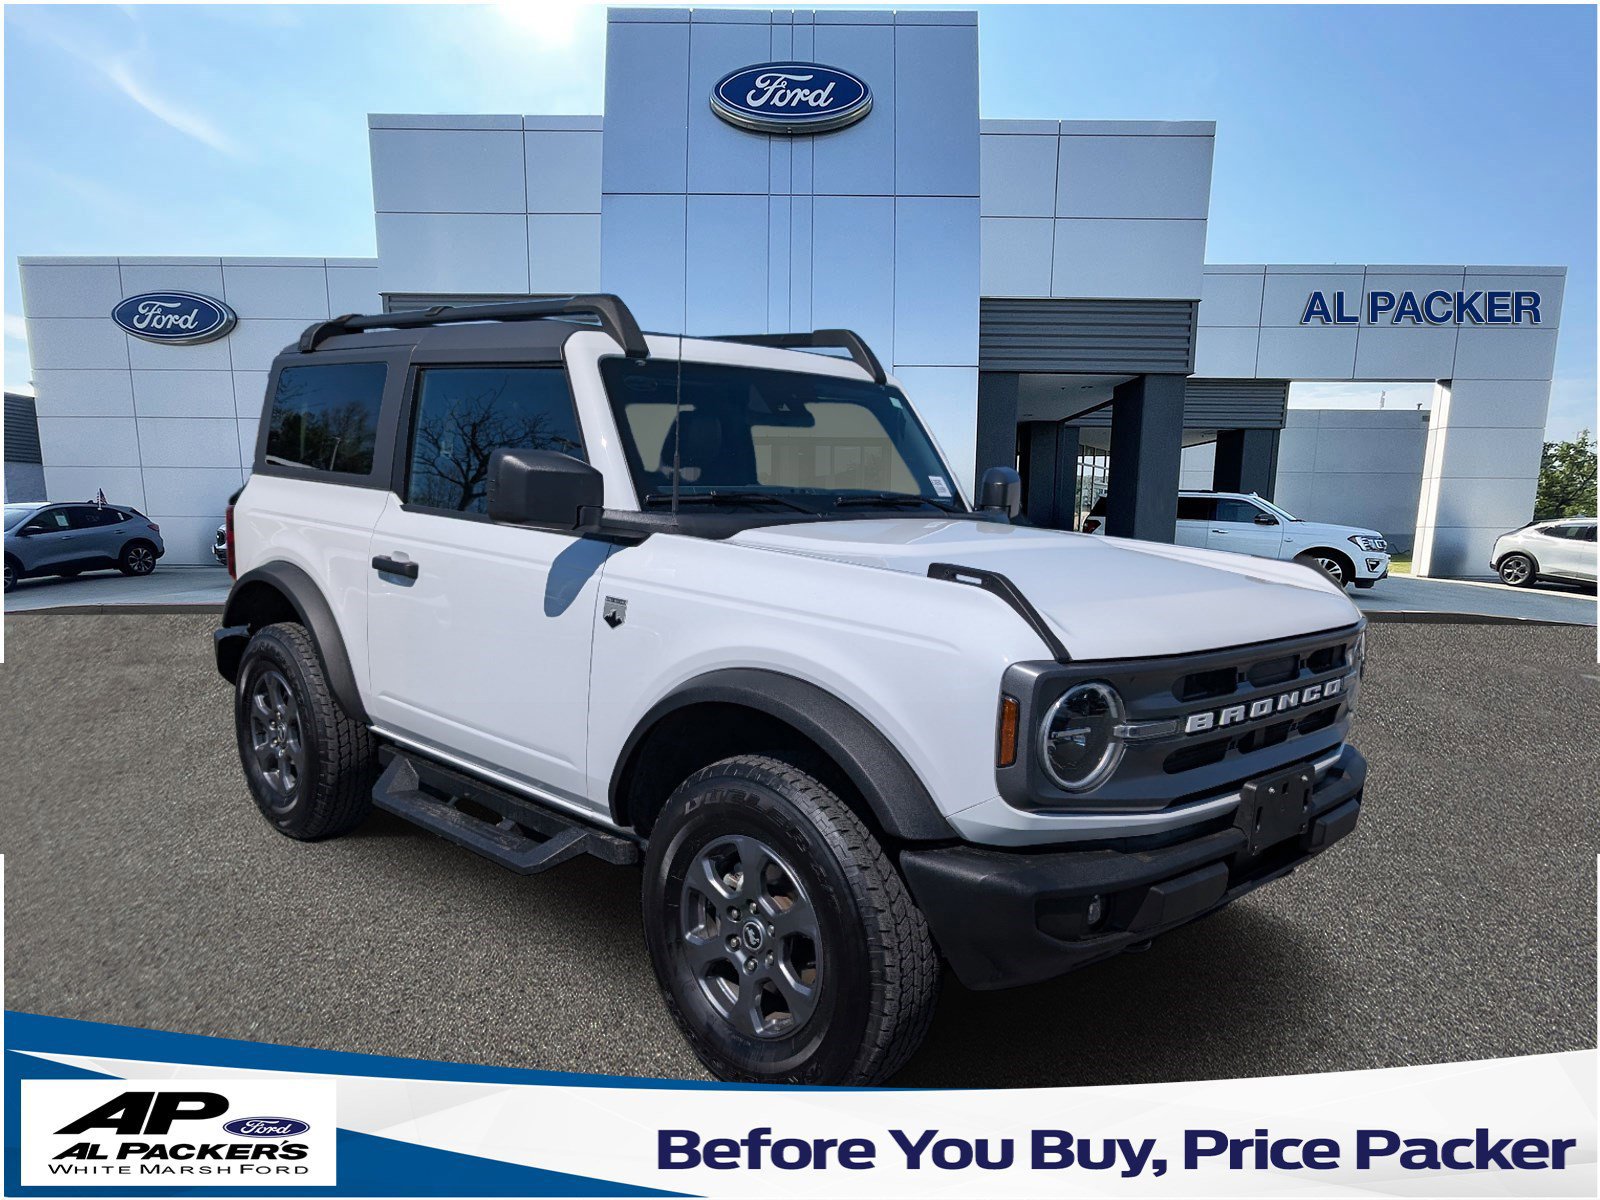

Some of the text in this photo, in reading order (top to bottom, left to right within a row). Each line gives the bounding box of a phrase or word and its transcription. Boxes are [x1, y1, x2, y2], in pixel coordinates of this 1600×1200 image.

[746, 73, 835, 108] Ford
[133, 301, 199, 329] Ford
[1301, 289, 1542, 326] AL PACKER
[1184, 678, 1342, 734] BRONCO
